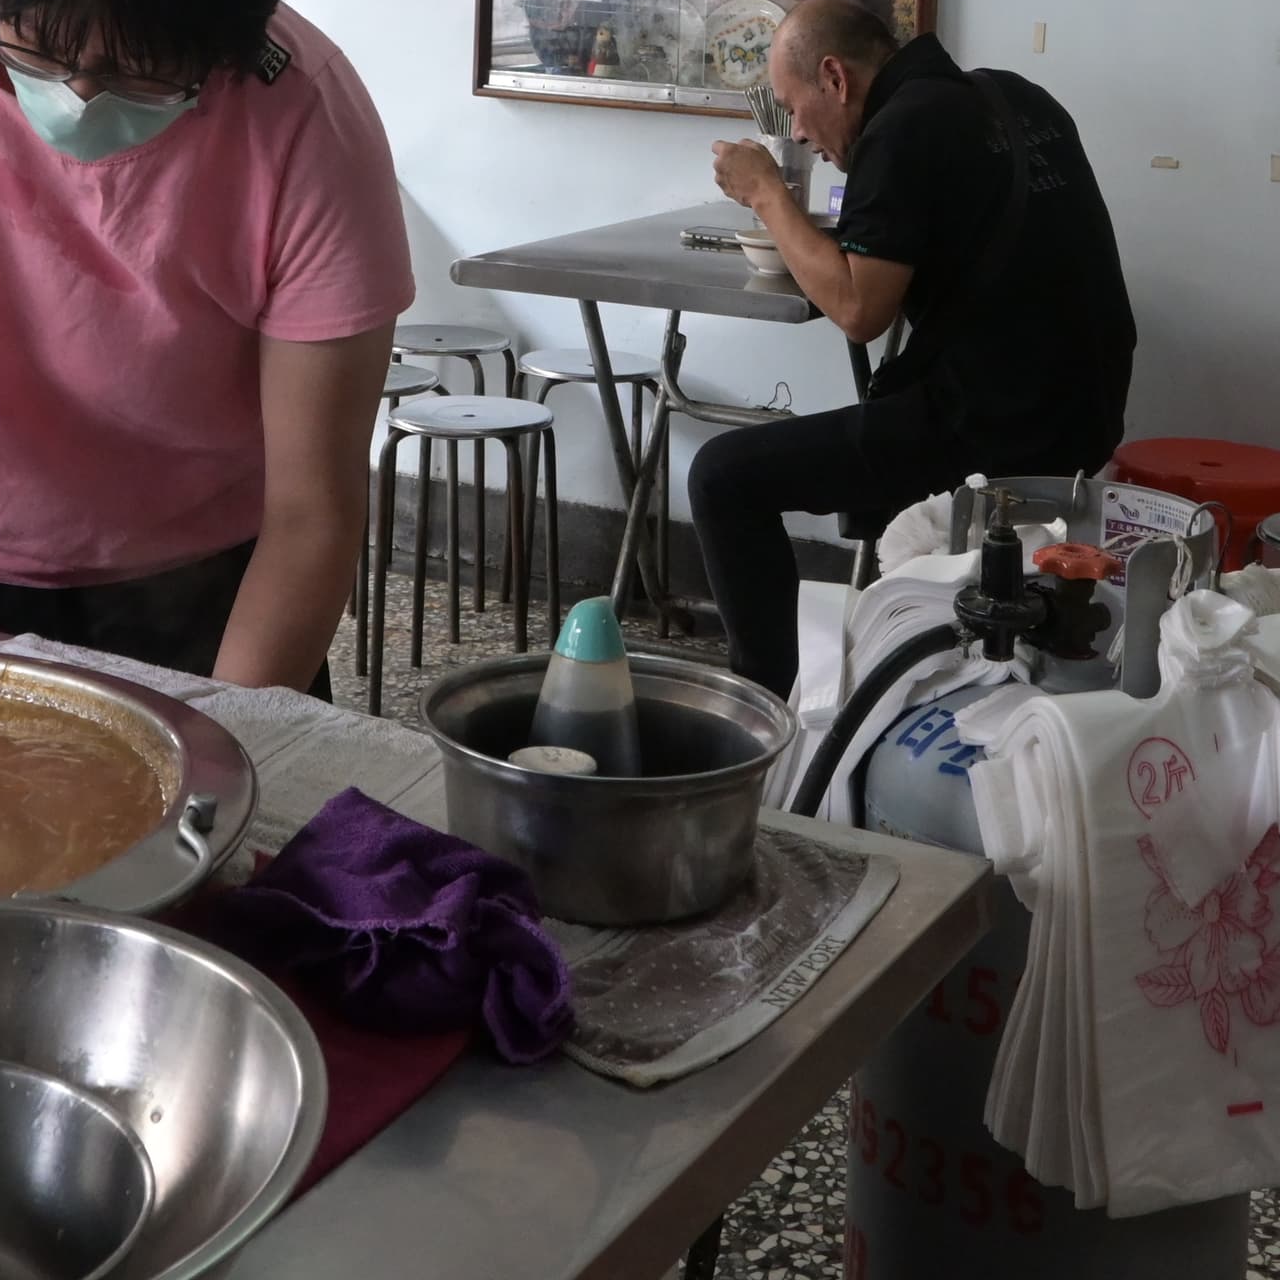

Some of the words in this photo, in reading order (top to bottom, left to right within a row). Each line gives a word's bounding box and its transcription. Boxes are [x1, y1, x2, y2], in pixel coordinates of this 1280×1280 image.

[1137, 754, 1188, 804] 2斤
[761, 967, 809, 1008] NEW
[804, 934, 847, 975] PORT
